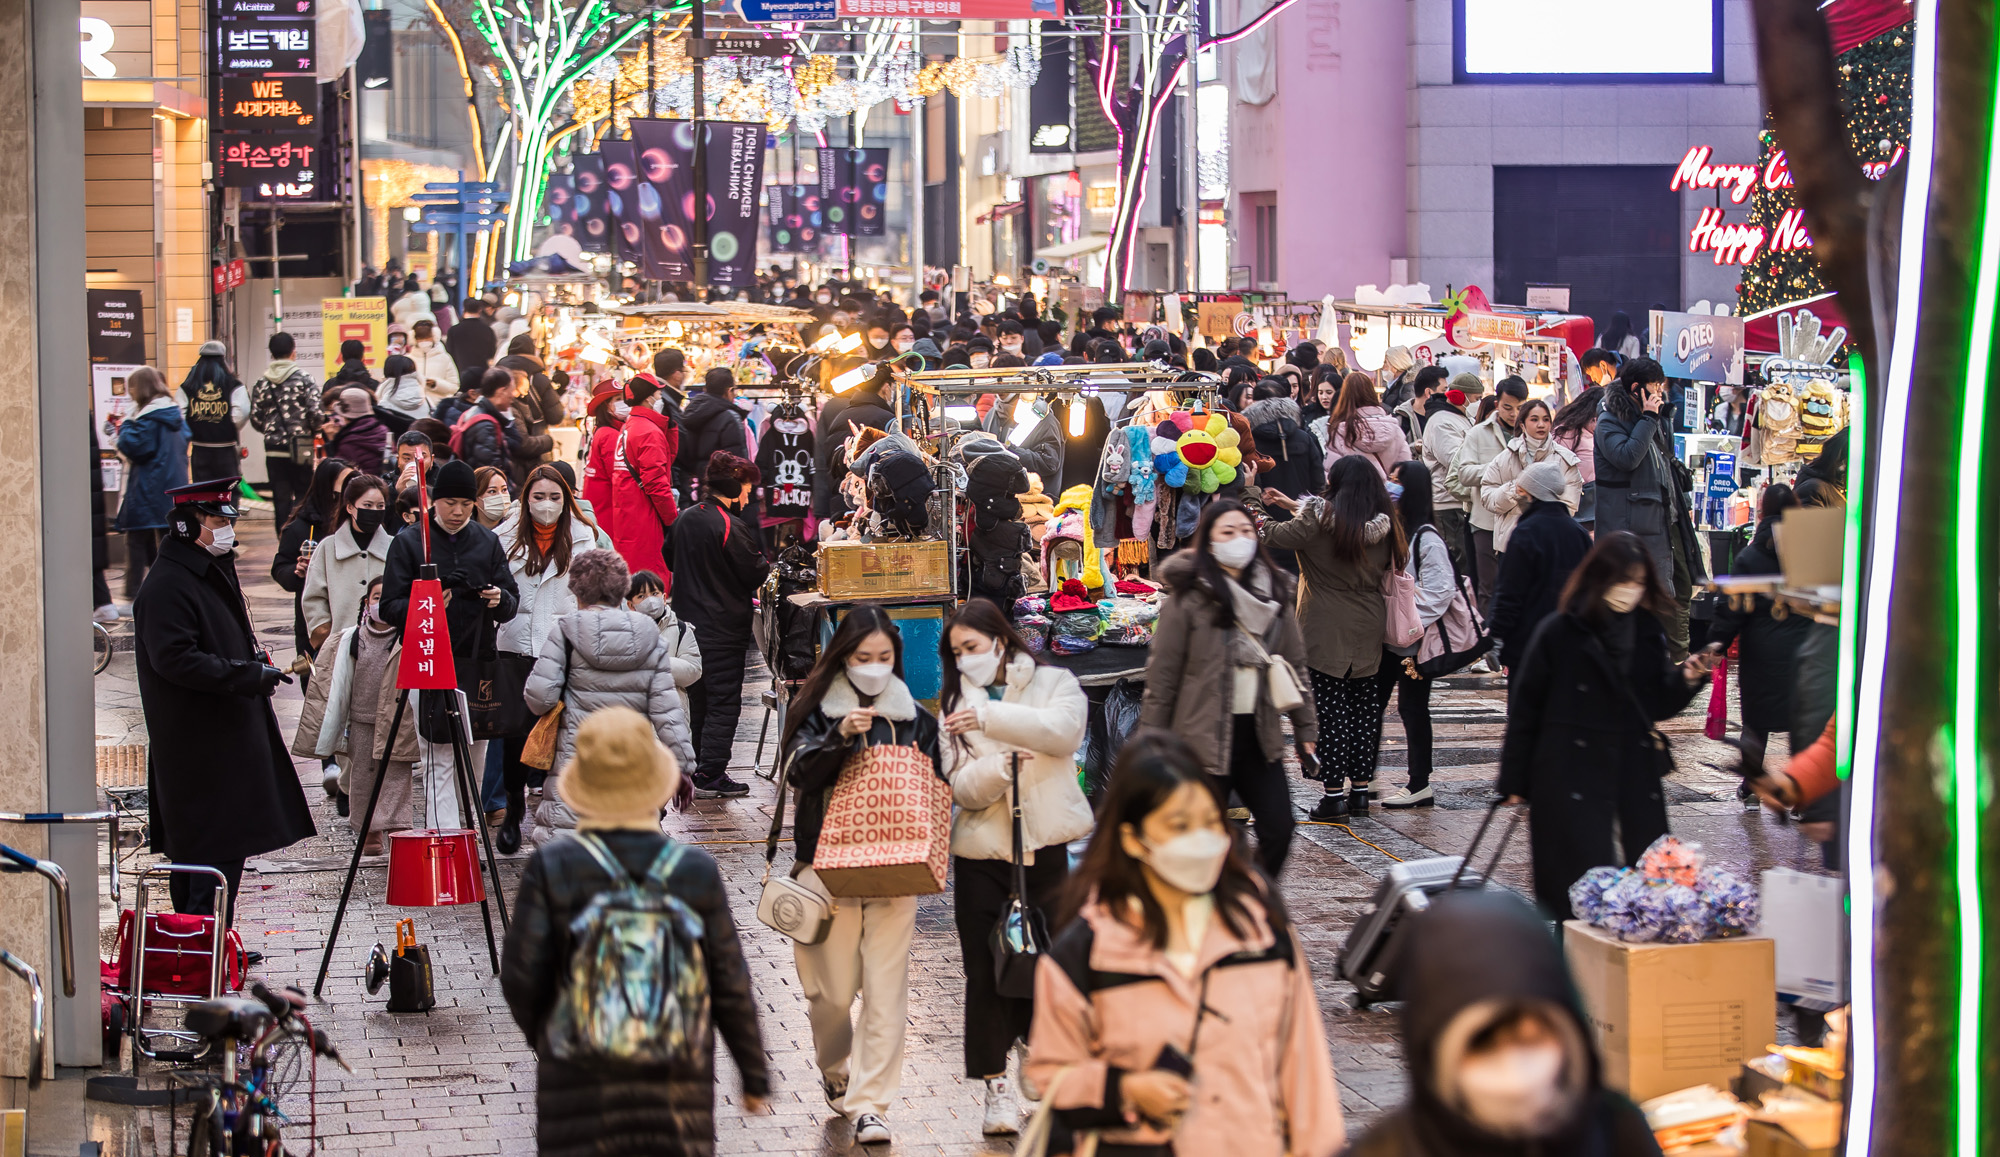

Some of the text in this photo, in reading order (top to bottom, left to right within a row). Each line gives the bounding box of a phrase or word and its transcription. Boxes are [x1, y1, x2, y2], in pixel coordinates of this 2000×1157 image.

[234, 2, 276, 12] Alcatraz
[761, 1, 835, 12] Myeongdong 8-gil
[847, 0, 961, 14] 명동관광특구협의회
[228, 28, 309, 51] 보드게임
[229, 58, 311, 69] MONACO 7F
[252, 80, 284, 98] WE
[233, 100, 303, 117] 시계거래소
[297, 114, 314, 126] 6F
[226, 141, 315, 168] 약손명가
[297, 170, 314, 182] 5F
[1670, 145, 1761, 204] Merry
[1689, 207, 1768, 265] Happy
[347, 300, 385, 310] HELLO
[324, 311, 386, 321] Foot Massage
[110, 320, 122, 329] 1st
[1677, 323, 1714, 361] OREO
[1763, 357, 1836, 380] OREO
[190, 397, 229, 417] SAPPORO
[1710, 484, 1735, 493] churros
[1713, 479, 1731, 487] OREO
[417, 596, 437, 677] 자선냄비
